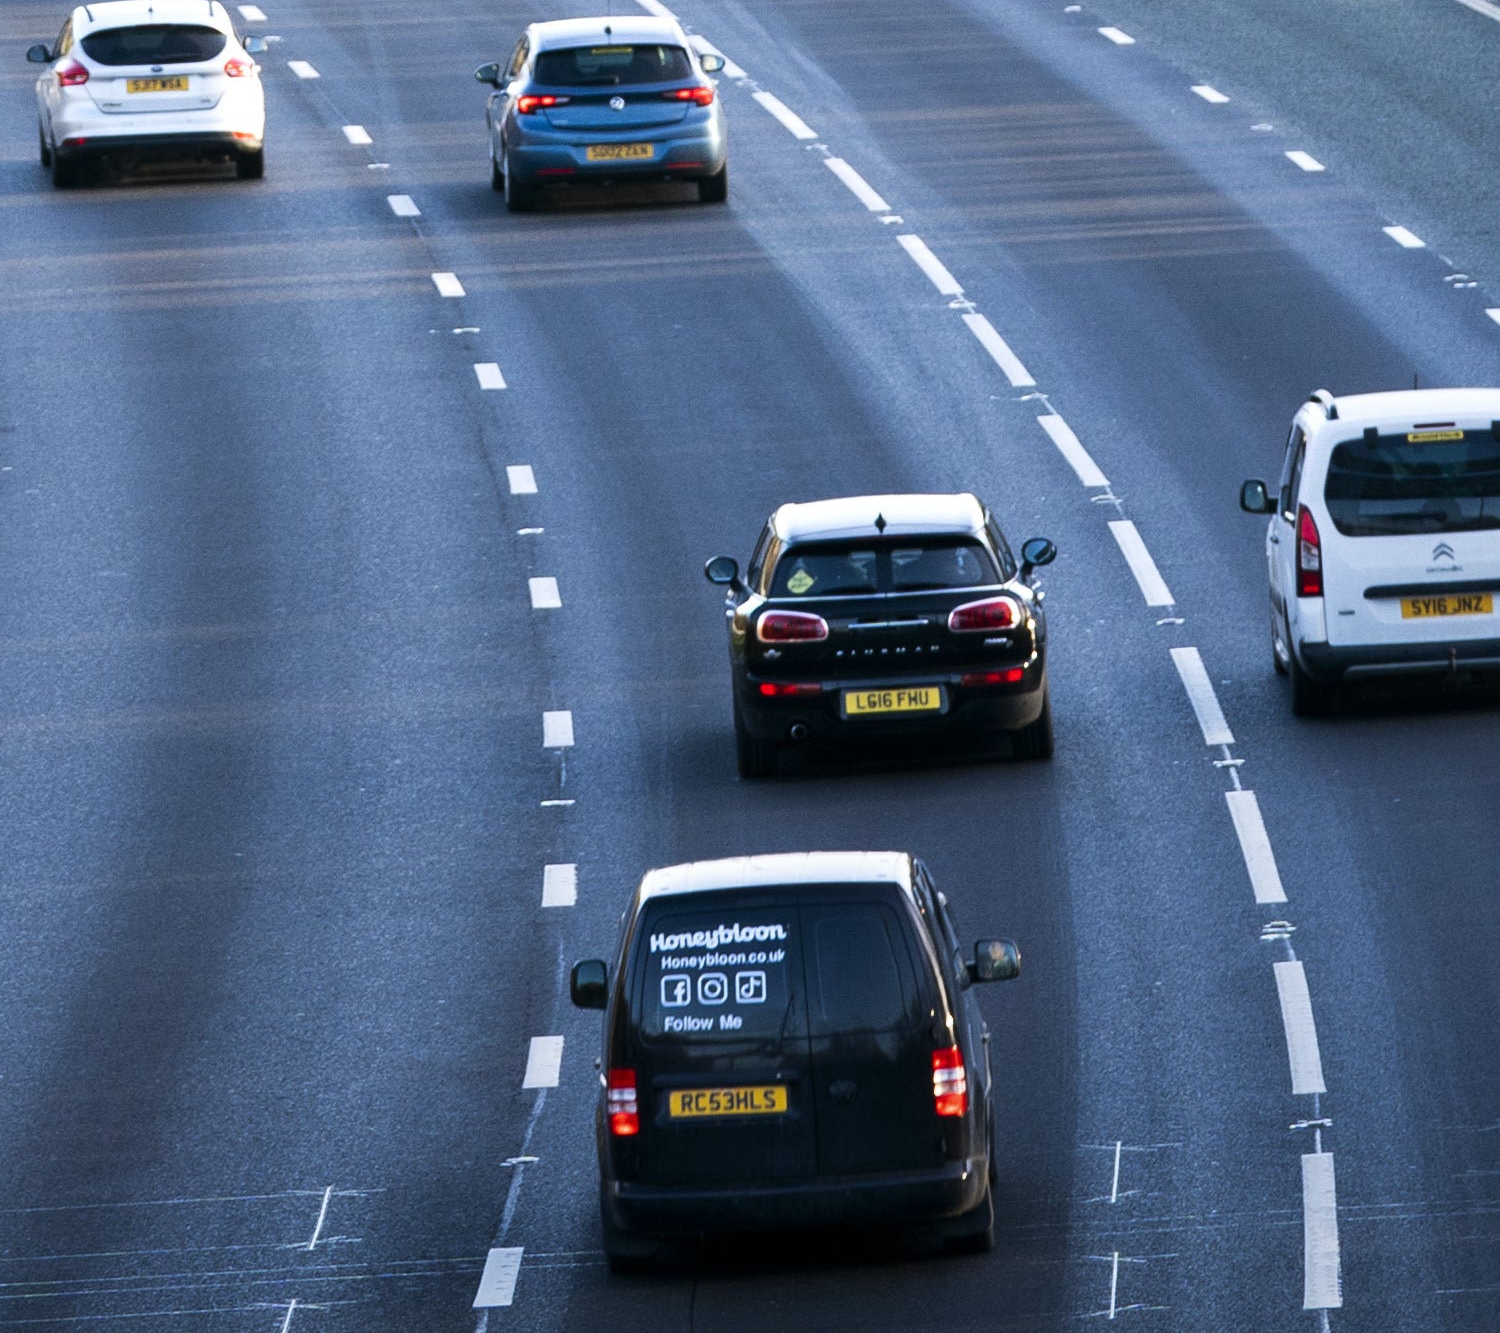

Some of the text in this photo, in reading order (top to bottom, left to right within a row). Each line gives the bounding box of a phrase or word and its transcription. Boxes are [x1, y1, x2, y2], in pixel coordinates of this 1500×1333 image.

[1411, 595, 1483, 615] SY16 JNZ
[856, 693, 892, 709] LG16
[650, 923, 787, 953] Honeybloon
[661, 949, 785, 970] Honeybloon.co.uk
[664, 1014, 743, 1032] Follow Me
[680, 1089, 776, 1113] RC53HLS
